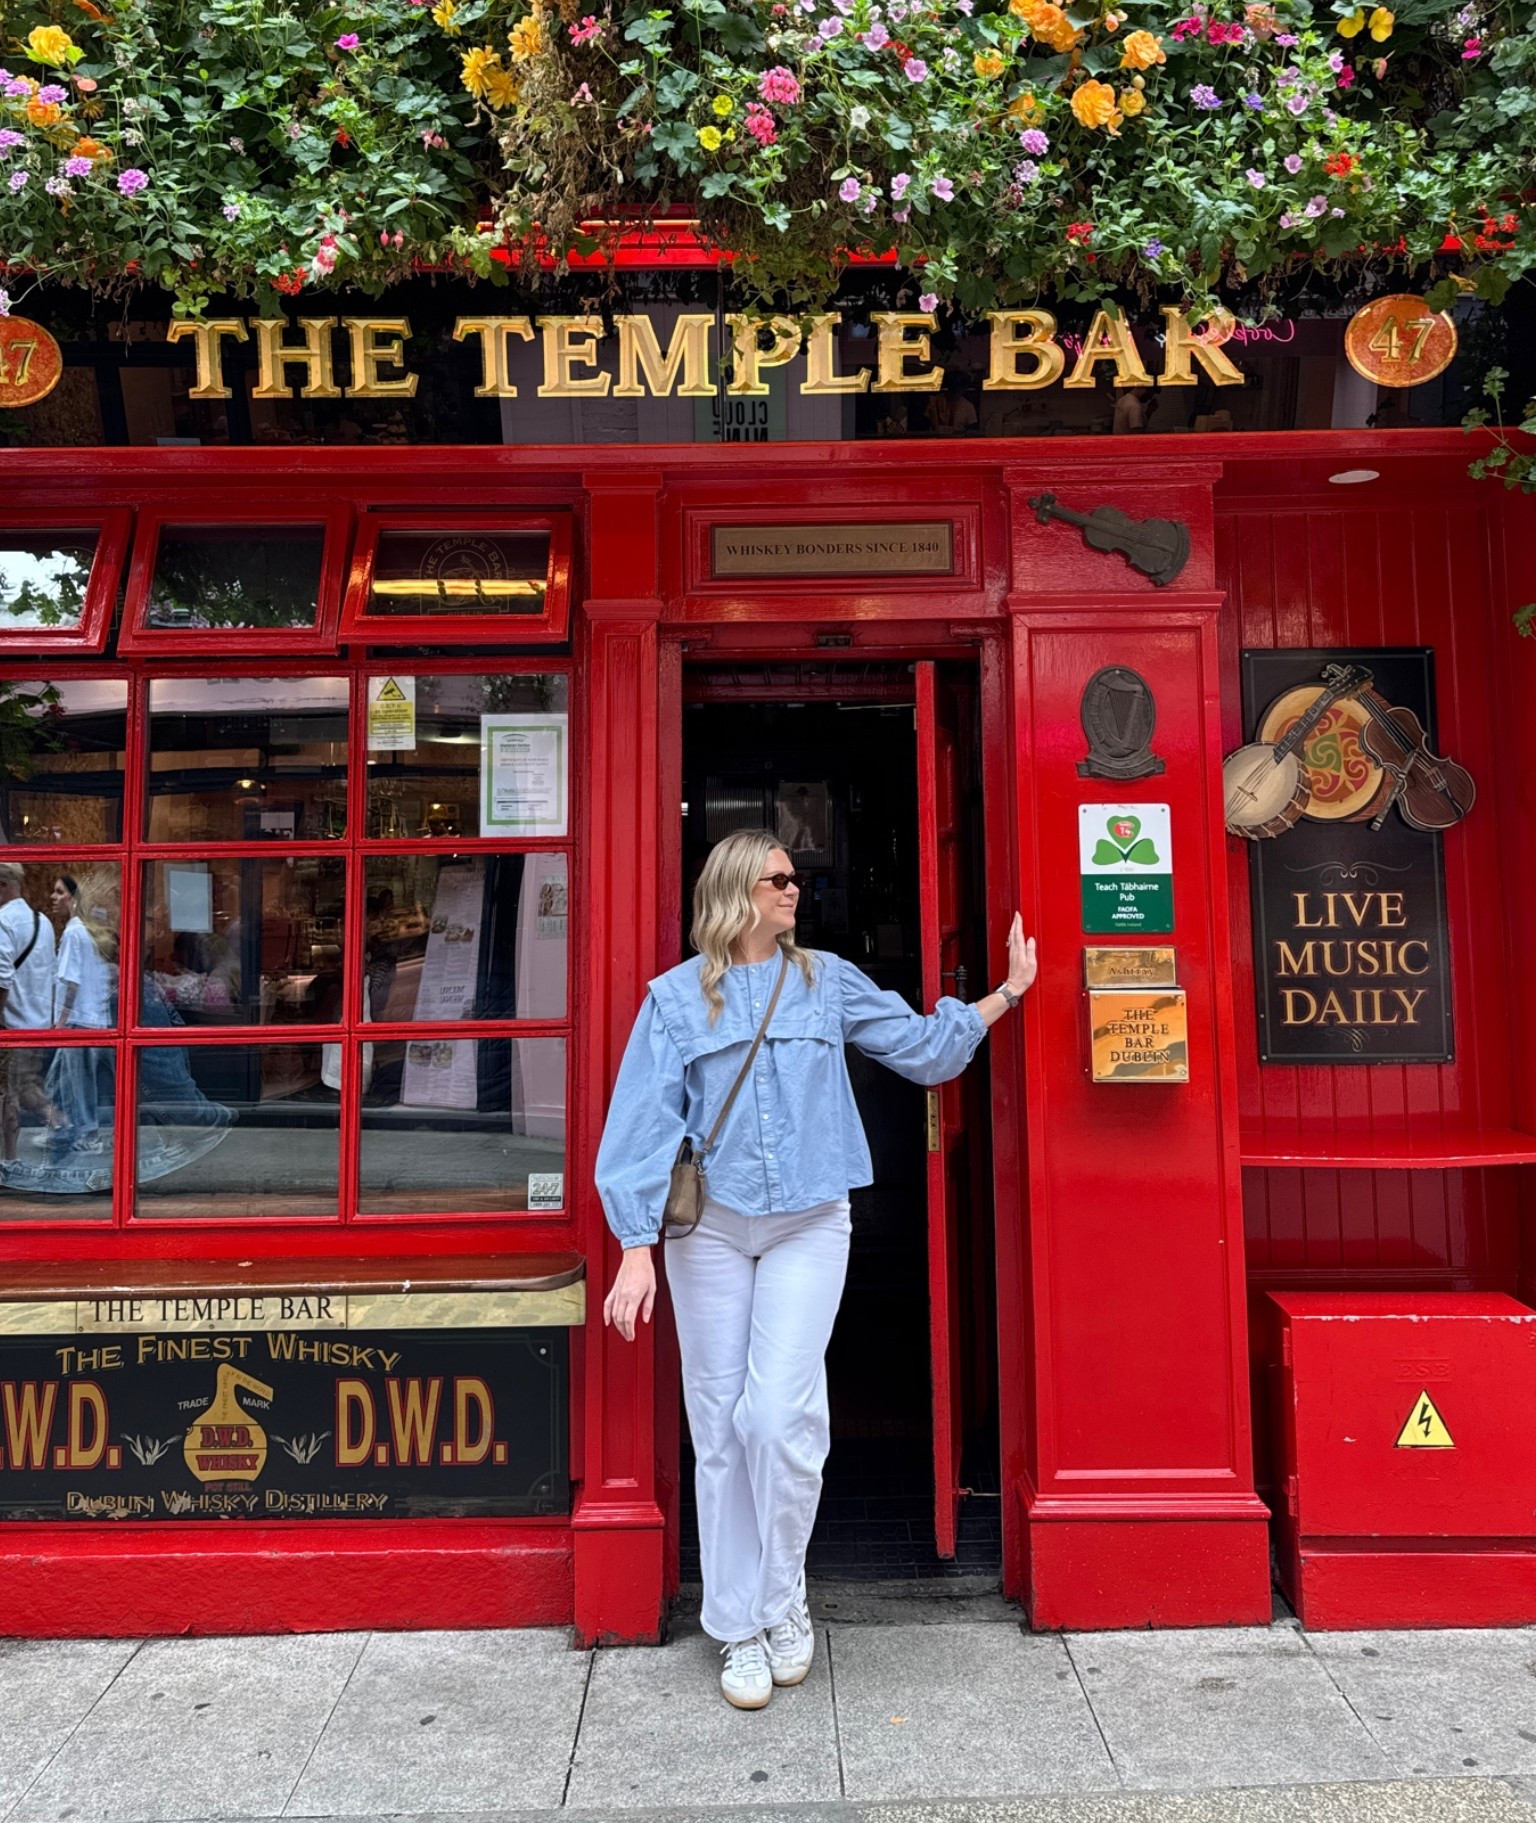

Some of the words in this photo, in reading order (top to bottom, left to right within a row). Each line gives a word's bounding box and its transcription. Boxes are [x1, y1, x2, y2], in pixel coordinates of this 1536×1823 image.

[1369, 315, 1437, 366] 47
[166, 316, 420, 399] THE
[452, 310, 945, 398] TEMPLE
[982, 304, 1245, 391] BAR
[435, 537, 489, 555] TEMPLE
[726, 544, 791, 556] WHISKEY
[796, 542, 863, 555] BONDERS
[866, 541, 908, 554] SINCE
[912, 541, 939, 553] 1840
[1094, 882, 1118, 891] Teach
[1119, 893, 1136, 901] Pub
[1111, 912, 1145, 920] APPROVED
[1292, 891, 1408, 929] LIVE
[1275, 940, 1430, 976] MUSIC
[1123, 1008, 1155, 1021] THE
[1281, 987, 1429, 1026] DAILY
[1109, 1023, 1169, 1035] TEMPLE
[1125, 1037, 1154, 1048] BAR
[1110, 1050, 1170, 1063] DUBLIN
[90, 1298, 144, 1323] THE
[159, 1296, 267, 1322] TEMPLE
[280, 1295, 335, 1321] BAR
[56, 1344, 124, 1375] THE
[137, 1335, 253, 1365] FINEST
[266, 1332, 402, 1374] WHISKY
[177, 1396, 210, 1411] TRADE
[242, 1396, 271, 1410] MARK
[0, 1379, 122, 1471] W.D.
[335, 1376, 508, 1468] D.W.D.
[200, 1426, 254, 1448] D.W.D.
[195, 1453, 260, 1472] WHISKY
[66, 1490, 155, 1513] DUBLIN
[161, 1490, 259, 1513] WHISKY
[265, 1489, 389, 1513] DISTILLERY
